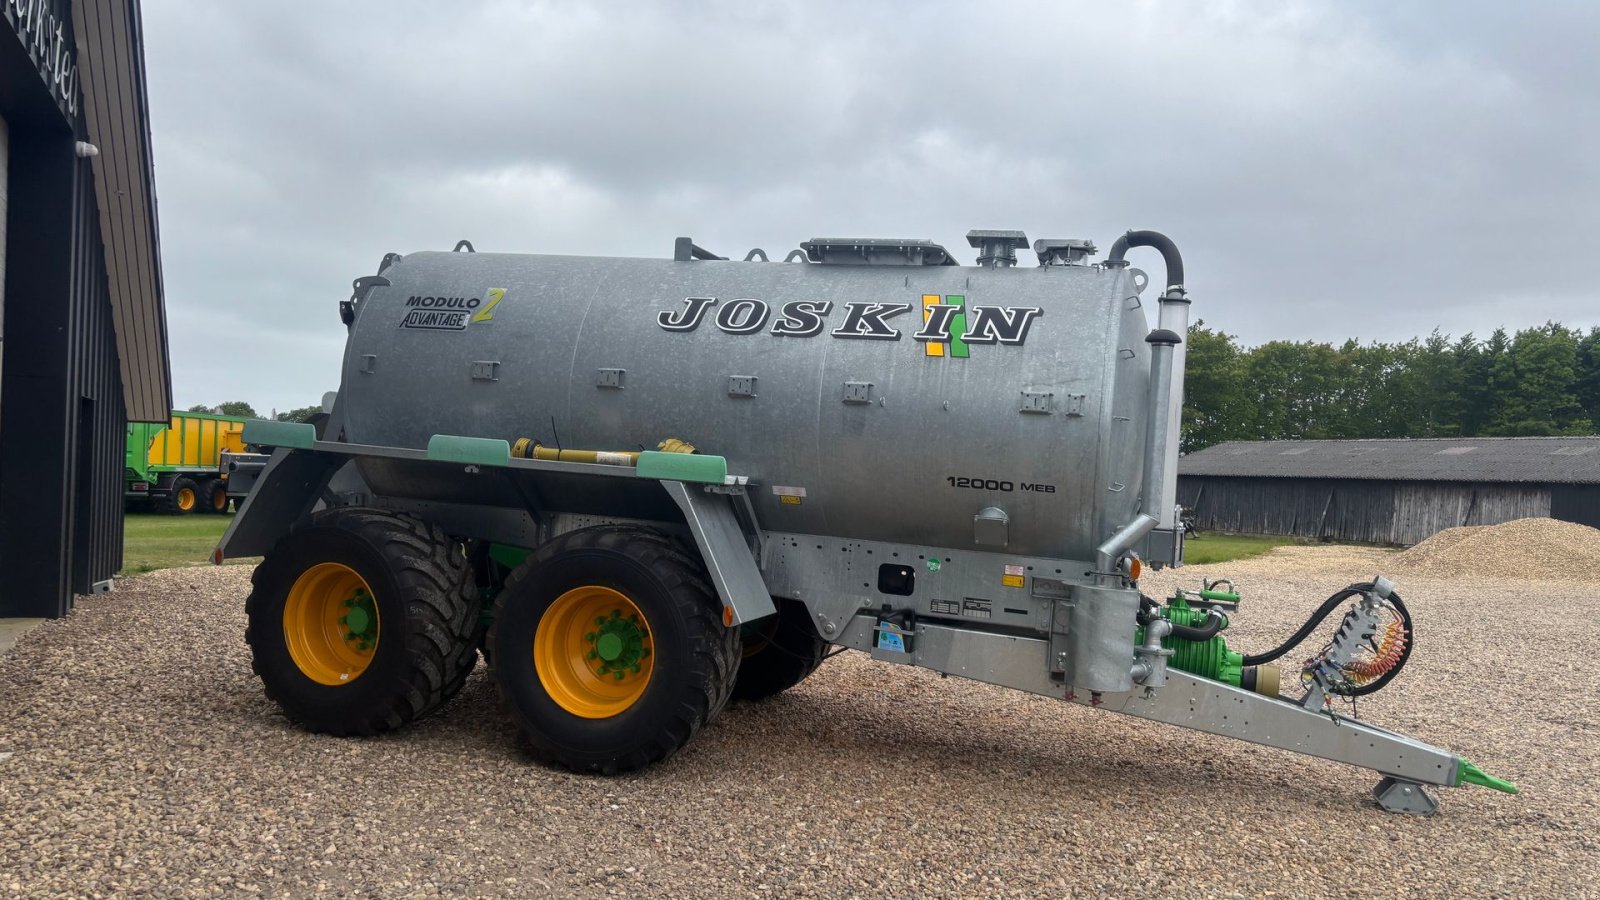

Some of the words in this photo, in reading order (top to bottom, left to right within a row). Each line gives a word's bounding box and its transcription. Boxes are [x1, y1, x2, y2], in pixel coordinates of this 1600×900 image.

[405, 296, 481, 309] MODULO
[472, 287, 506, 324] 2
[399, 311, 466, 328] ADVANTAGE
[656, 295, 1044, 346] JOSKIN
[946, 476, 1014, 492] 12000
[1020, 482, 1056, 494] MEB
